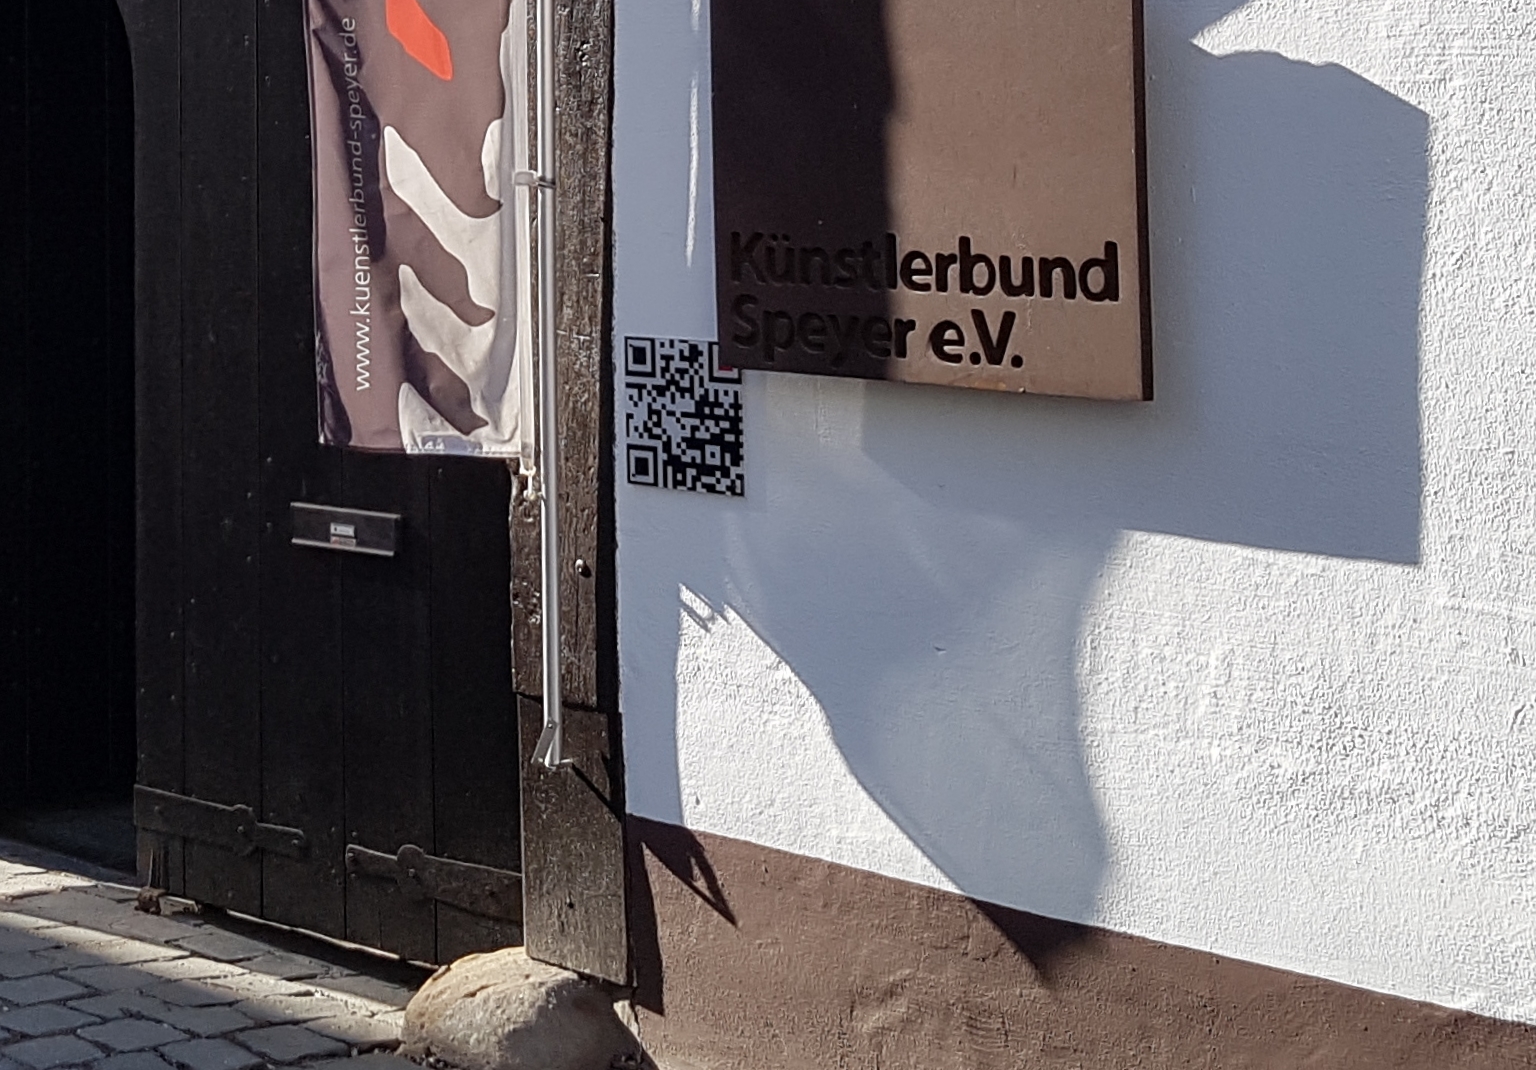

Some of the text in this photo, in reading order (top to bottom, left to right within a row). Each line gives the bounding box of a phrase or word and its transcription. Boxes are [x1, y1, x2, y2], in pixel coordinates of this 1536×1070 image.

[340, 16, 372, 392] www.kuenstlerbund-speyer.de
[730, 232, 1120, 302] Künstlerbund
[732, 294, 1024, 370] Speyer e.V.
